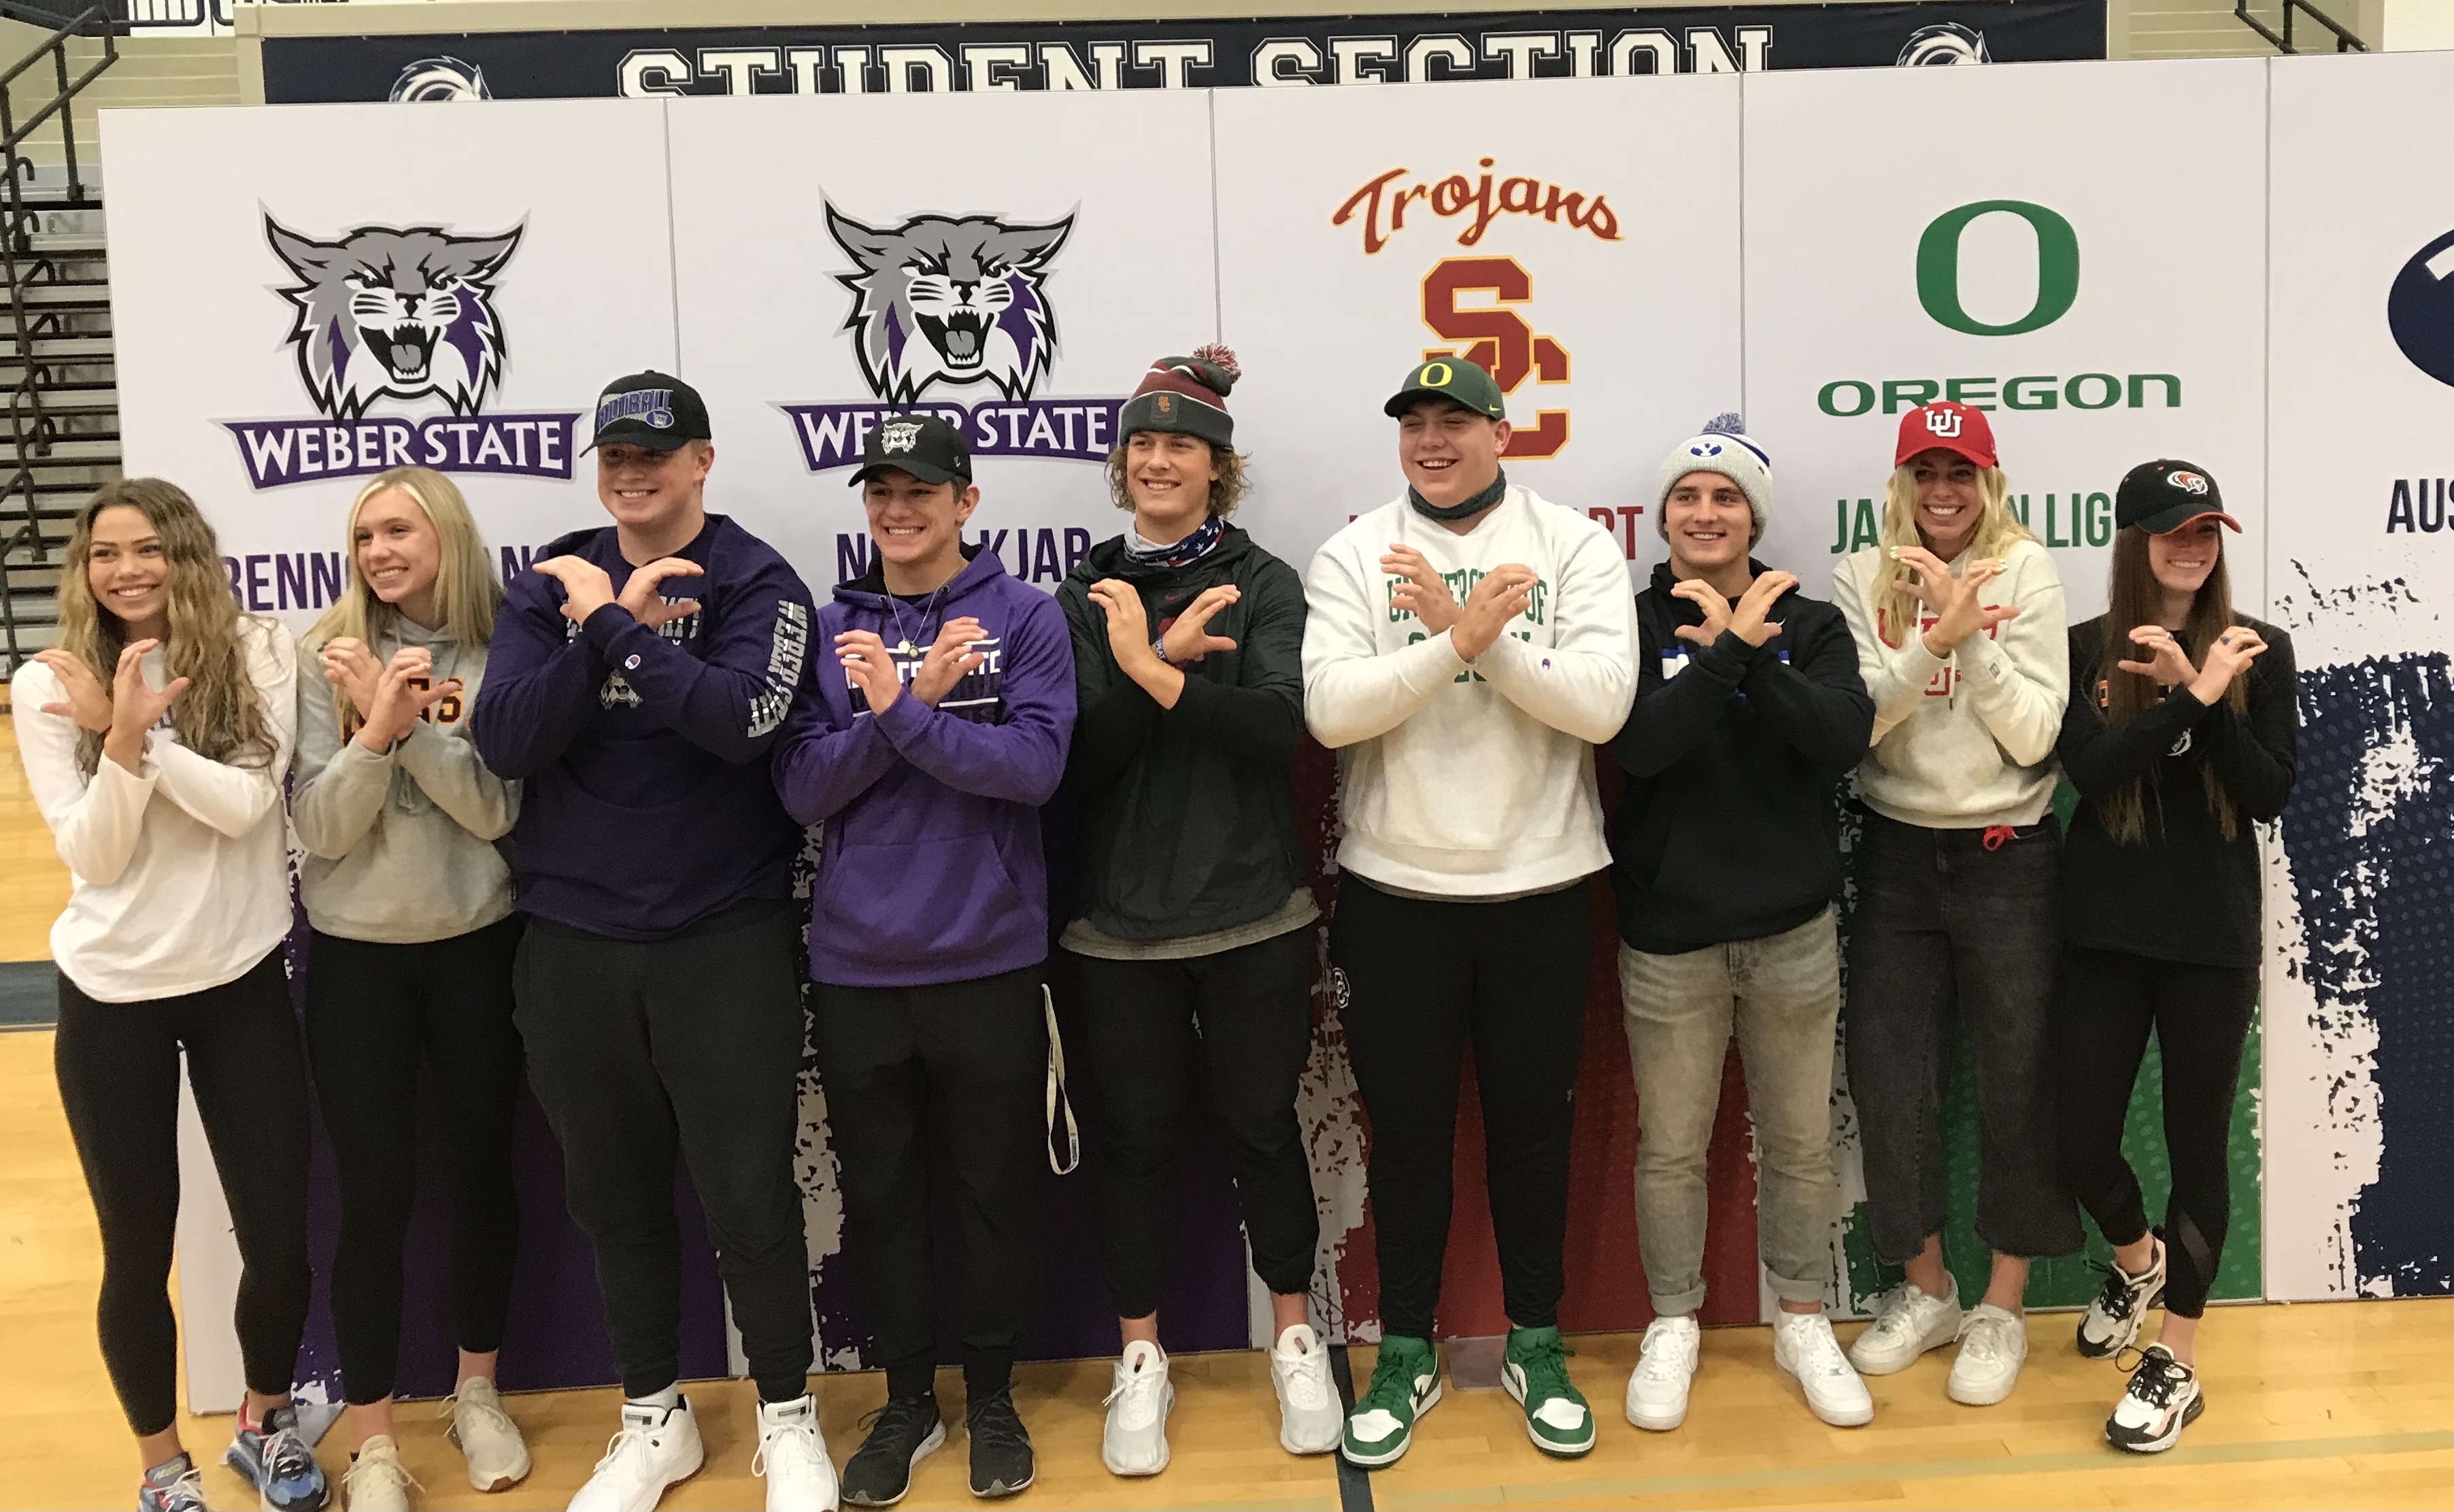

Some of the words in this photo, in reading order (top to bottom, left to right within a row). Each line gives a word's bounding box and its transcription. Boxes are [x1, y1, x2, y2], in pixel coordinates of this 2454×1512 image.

[1331, 158, 1625, 255] Trojans
[1916, 200, 2080, 336] O
[1419, 363, 1453, 387] O
[1817, 373, 2181, 417] OREGON
[242, 424, 412, 481] WEBER
[424, 422, 563, 471] STATE
[977, 407, 1109, 454] STATE
[2046, 492, 2111, 548] LIG
[2387, 477, 2454, 534] AU
